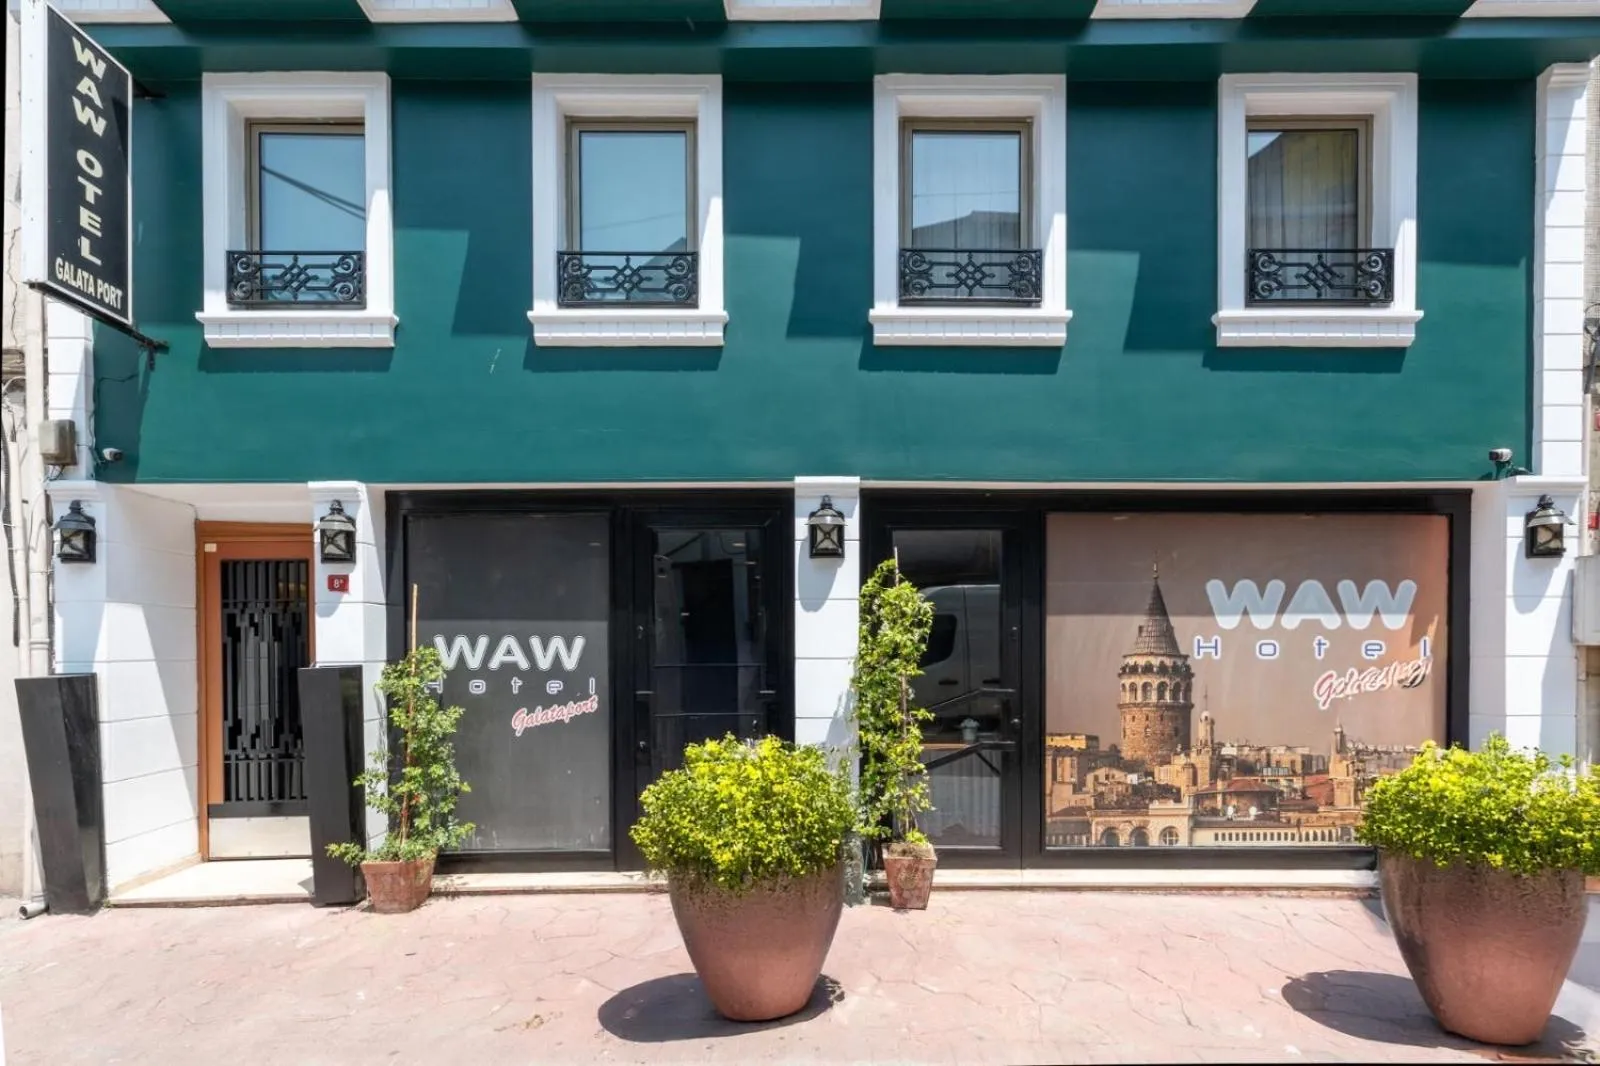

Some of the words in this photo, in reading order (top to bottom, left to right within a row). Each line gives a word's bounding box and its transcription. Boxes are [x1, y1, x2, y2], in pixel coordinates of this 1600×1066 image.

[72, 36, 107, 137] WAW
[77, 149, 103, 266] OTEL
[56, 257, 95, 297] GALATA
[97, 278, 122, 310] PORT
[1206, 579, 1417, 630] WAW
[433, 635, 586, 671] WAW
[1194, 636, 1431, 660] Hotel
[512, 695, 598, 736] Galataport
